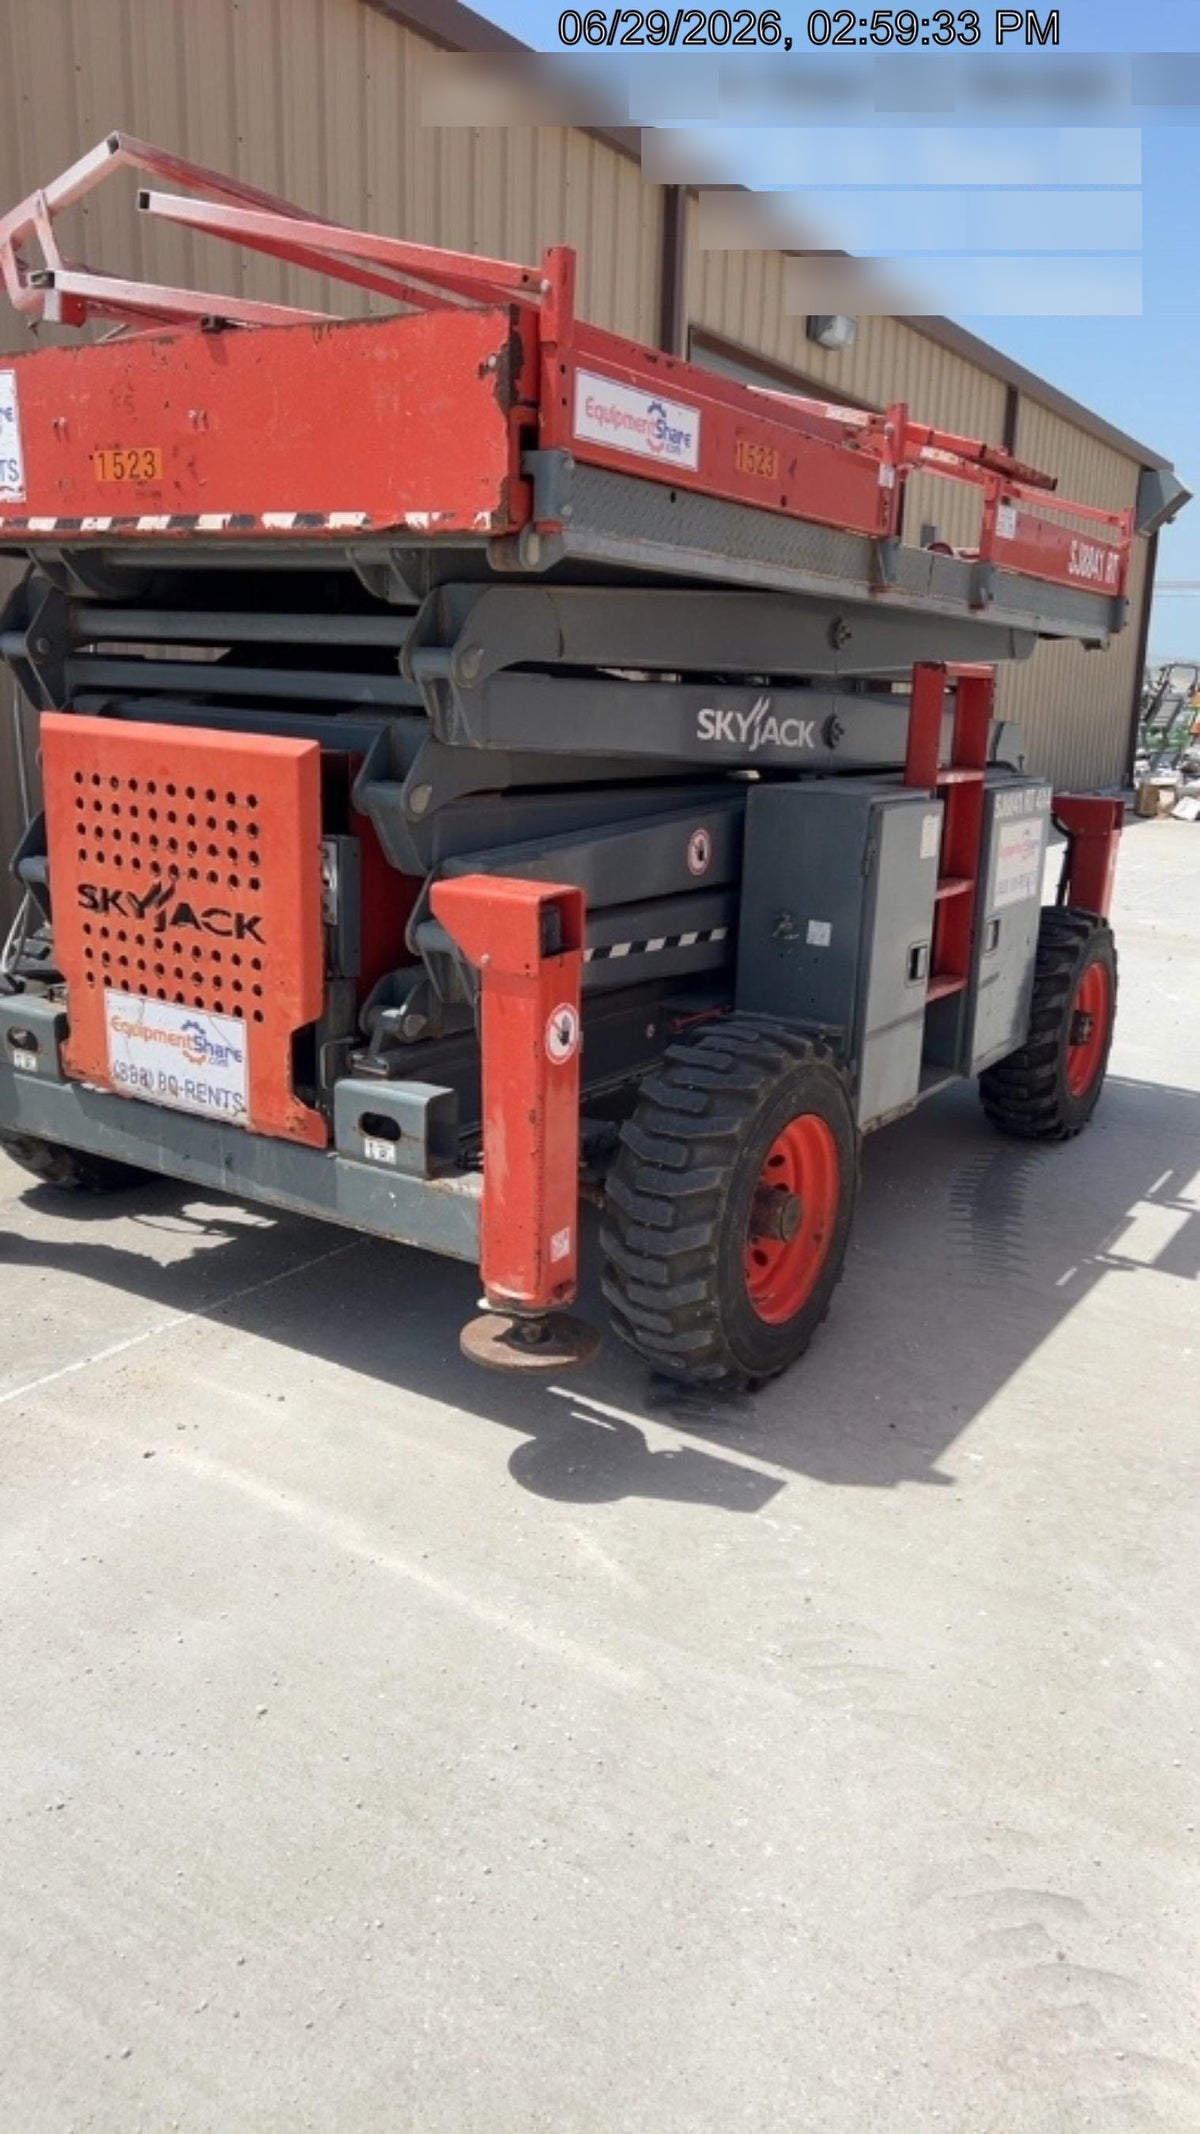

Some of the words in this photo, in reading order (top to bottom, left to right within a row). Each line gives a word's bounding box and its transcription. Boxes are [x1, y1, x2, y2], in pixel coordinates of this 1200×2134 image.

[97, 450, 157, 480] 1523
[697, 696, 815, 752] SKYJACK
[78, 881, 266, 944] SKYJACK
[111, 1014, 242, 1063] EquipmentShare
